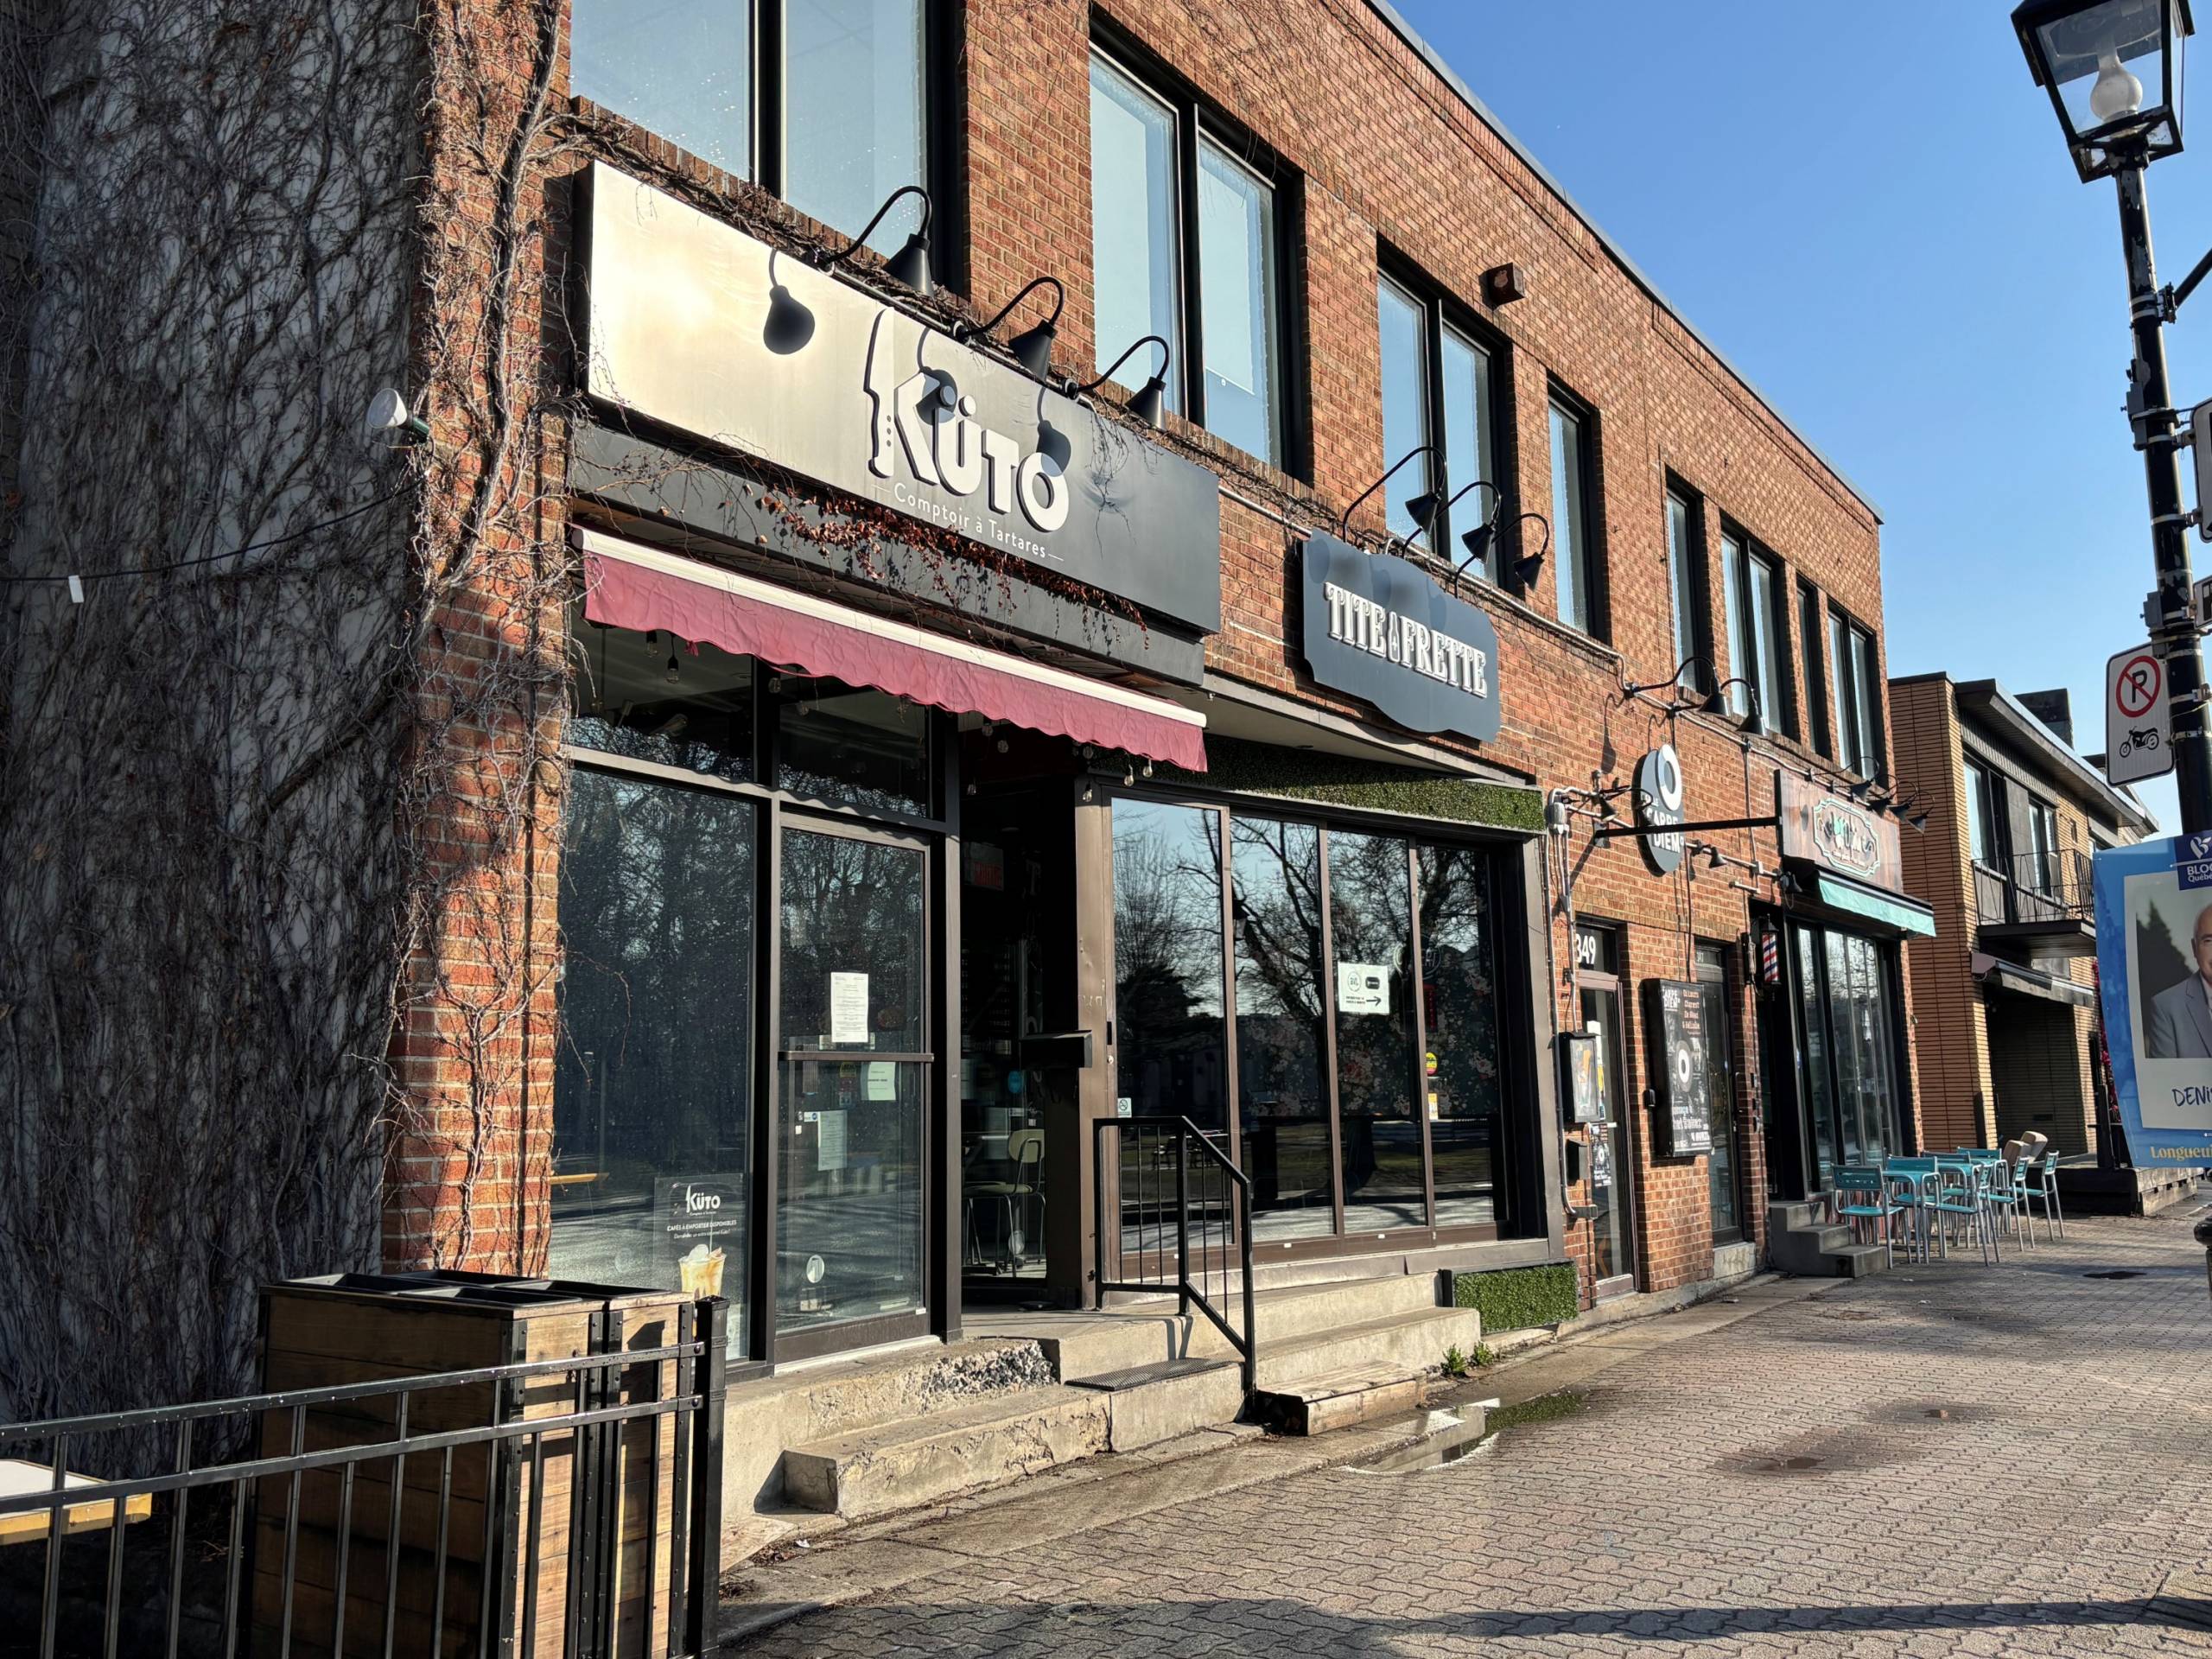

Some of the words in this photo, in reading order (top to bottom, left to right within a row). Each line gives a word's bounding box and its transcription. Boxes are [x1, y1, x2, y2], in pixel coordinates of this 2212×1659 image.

[893, 482, 970, 528] Comptoir
[976, 516, 983, 534] à
[988, 518, 1046, 558] Tartares
[1324, 581, 1387, 659] TITE
[1399, 614, 1488, 699] FRETTE
[1575, 933, 1597, 965] 349
